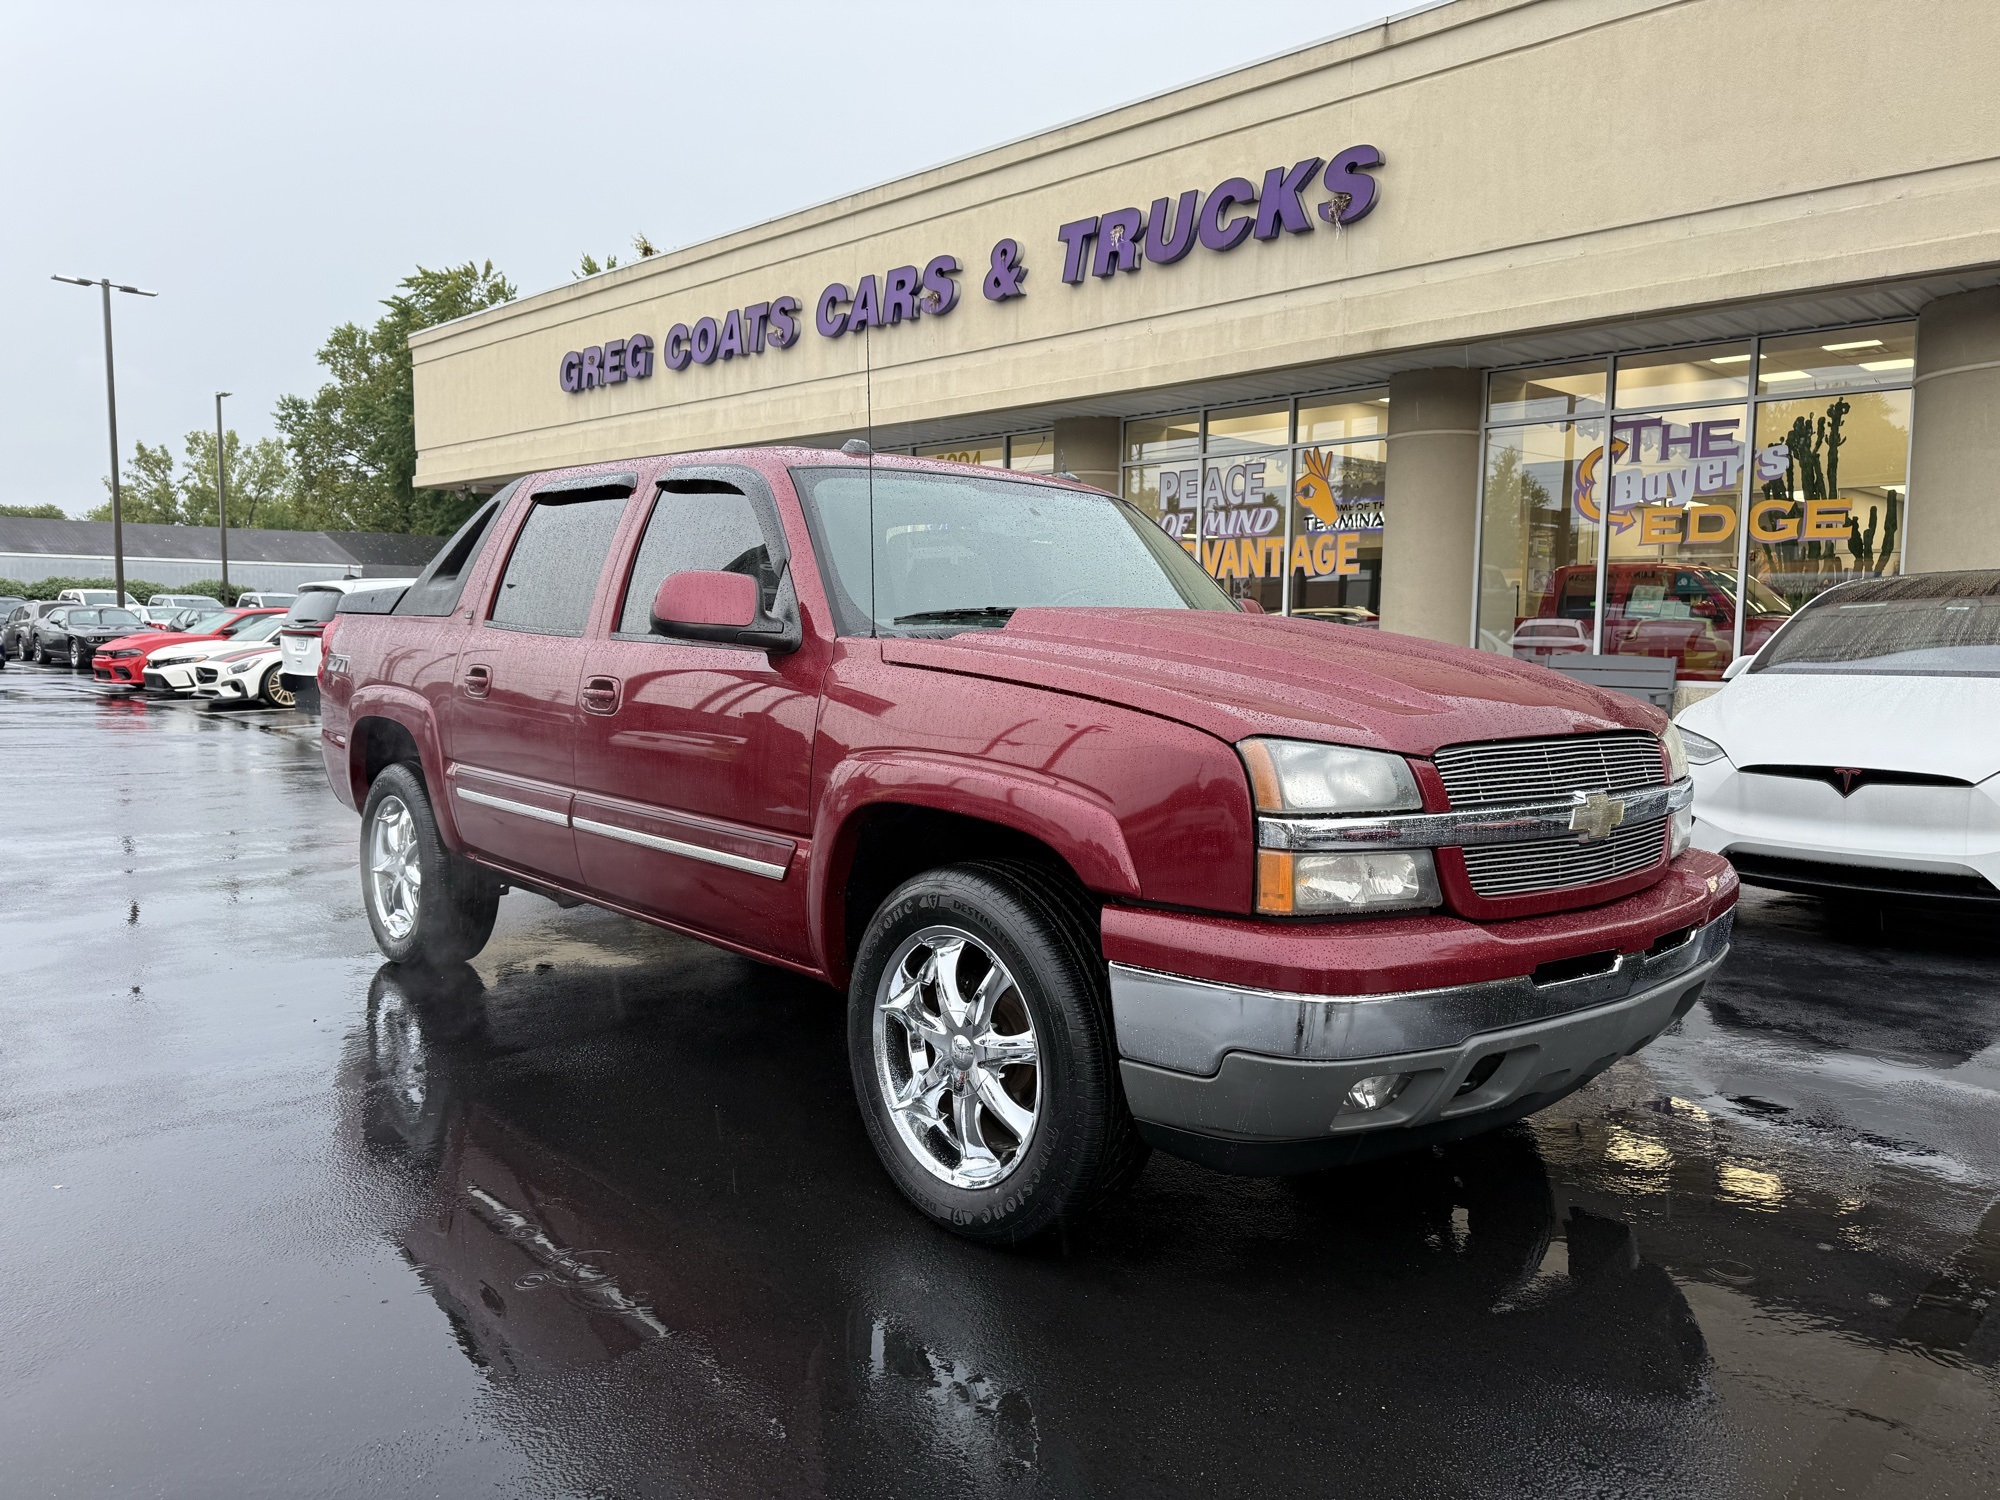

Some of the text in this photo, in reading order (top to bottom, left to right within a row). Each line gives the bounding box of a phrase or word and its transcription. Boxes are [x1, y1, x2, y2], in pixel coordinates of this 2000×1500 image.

[560, 144, 1386, 393] GREG COATS CARS & TRUCKS
[1612, 416, 1740, 464] THE
[1159, 462, 1266, 510] PEACE
[1356, 502, 1370, 511] OF
[1158, 507, 1279, 541] OF MIND
[1638, 498, 1853, 546] EDGE
